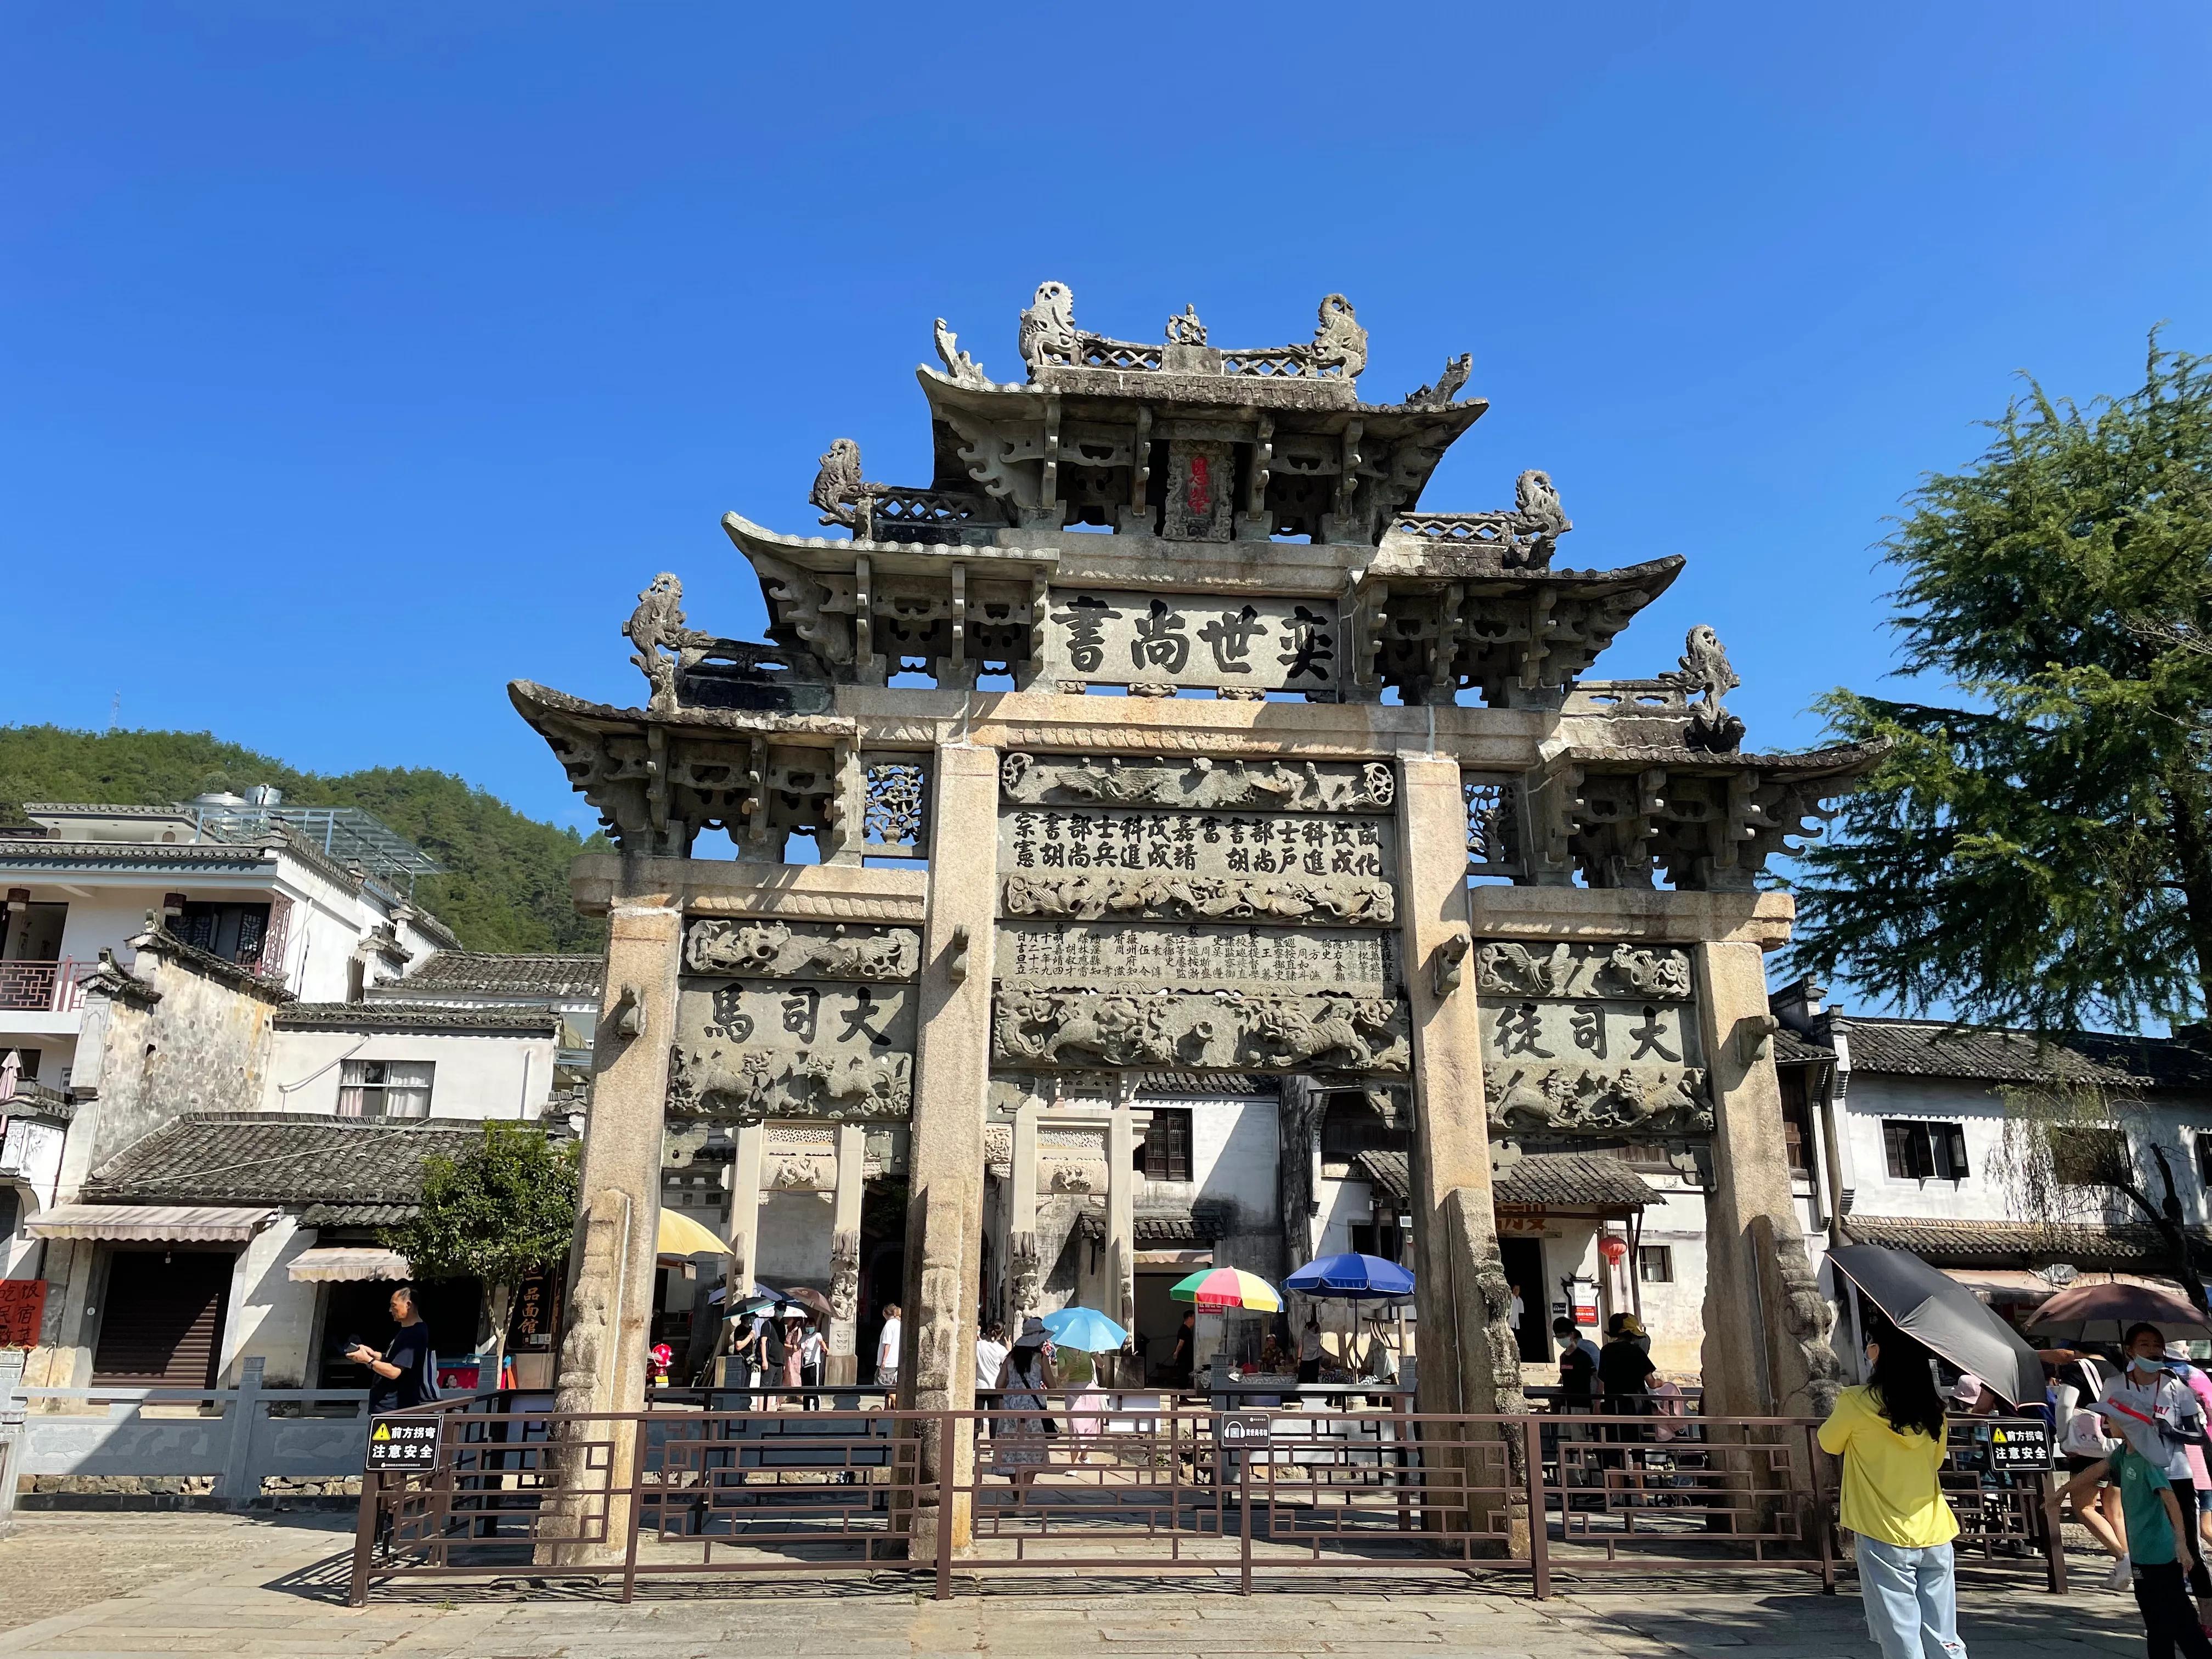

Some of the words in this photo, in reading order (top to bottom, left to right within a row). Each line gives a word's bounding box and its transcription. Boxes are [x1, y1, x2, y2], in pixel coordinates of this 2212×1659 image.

[518, 1266, 544, 1334] 一品面馆
[391, 1426, 436, 1439] 前方拐弯
[2006, 1430, 2044, 1441] 前方拐弯
[372, 1444, 433, 1458] 注意安全
[1995, 1446, 2047, 1459] 注意安全
